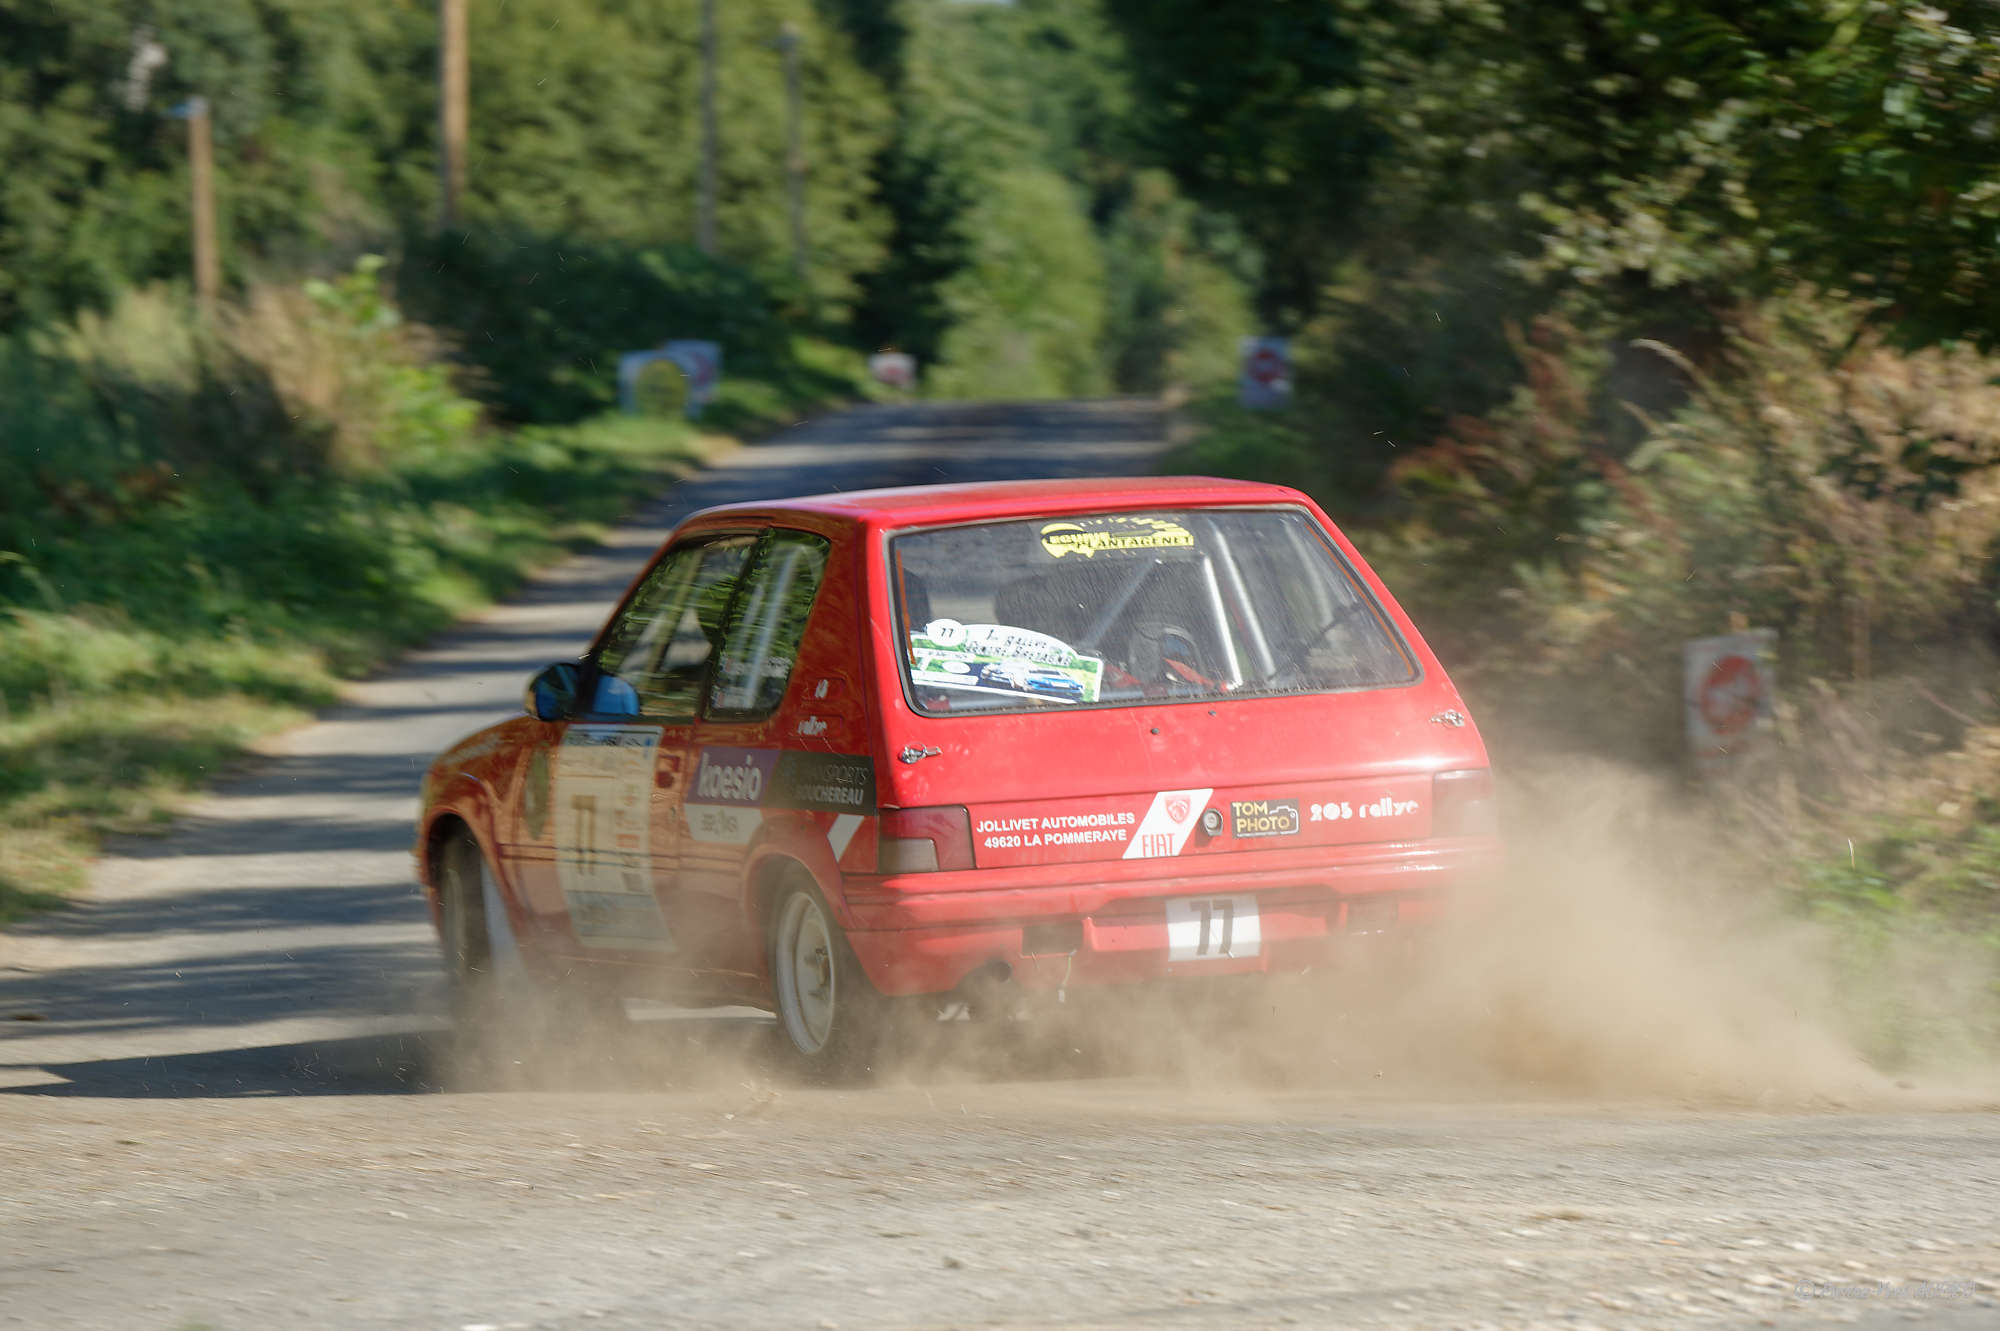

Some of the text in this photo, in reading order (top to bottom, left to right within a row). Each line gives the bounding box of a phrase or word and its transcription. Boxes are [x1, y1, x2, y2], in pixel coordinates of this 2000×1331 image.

[940, 627, 955, 638] 77
[697, 752, 761, 801] koesio
[1232, 801, 1268, 817] TOM
[1310, 797, 1419, 822] 205 rallye
[976, 812, 1135, 833] JOLLIVET AUTOMOBILES
[1236, 815, 1290, 833] PHOTO
[984, 829, 1127, 849] 49620 LA POMMERAYE
[1142, 833, 1176, 857] FIAT
[1189, 899, 1233, 956] 77
